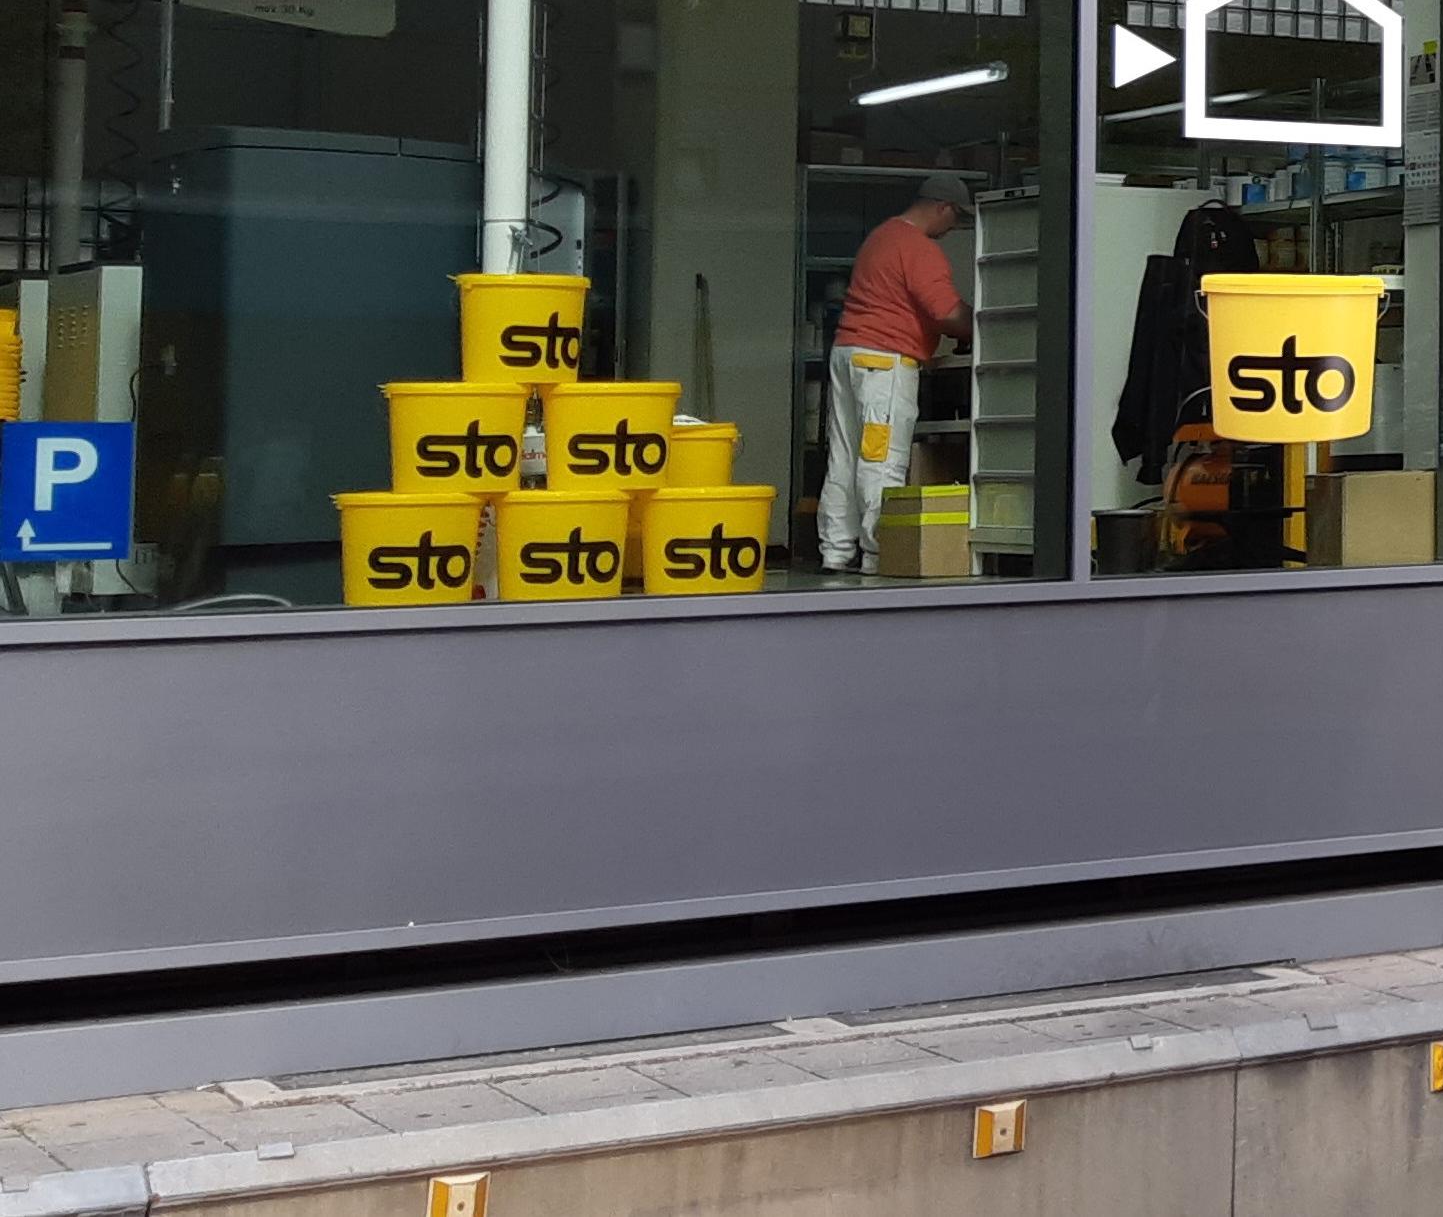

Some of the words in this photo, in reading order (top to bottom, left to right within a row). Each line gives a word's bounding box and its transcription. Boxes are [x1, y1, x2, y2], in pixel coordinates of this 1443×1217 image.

[498, 311, 580, 369] sto
[1227, 335, 1356, 415] sto
[33, 437, 98, 512] P
[416, 419, 518, 479] sto
[568, 418, 667, 476] sto
[367, 530, 472, 591] sto
[520, 525, 621, 585] sto
[663, 523, 762, 581] sto
